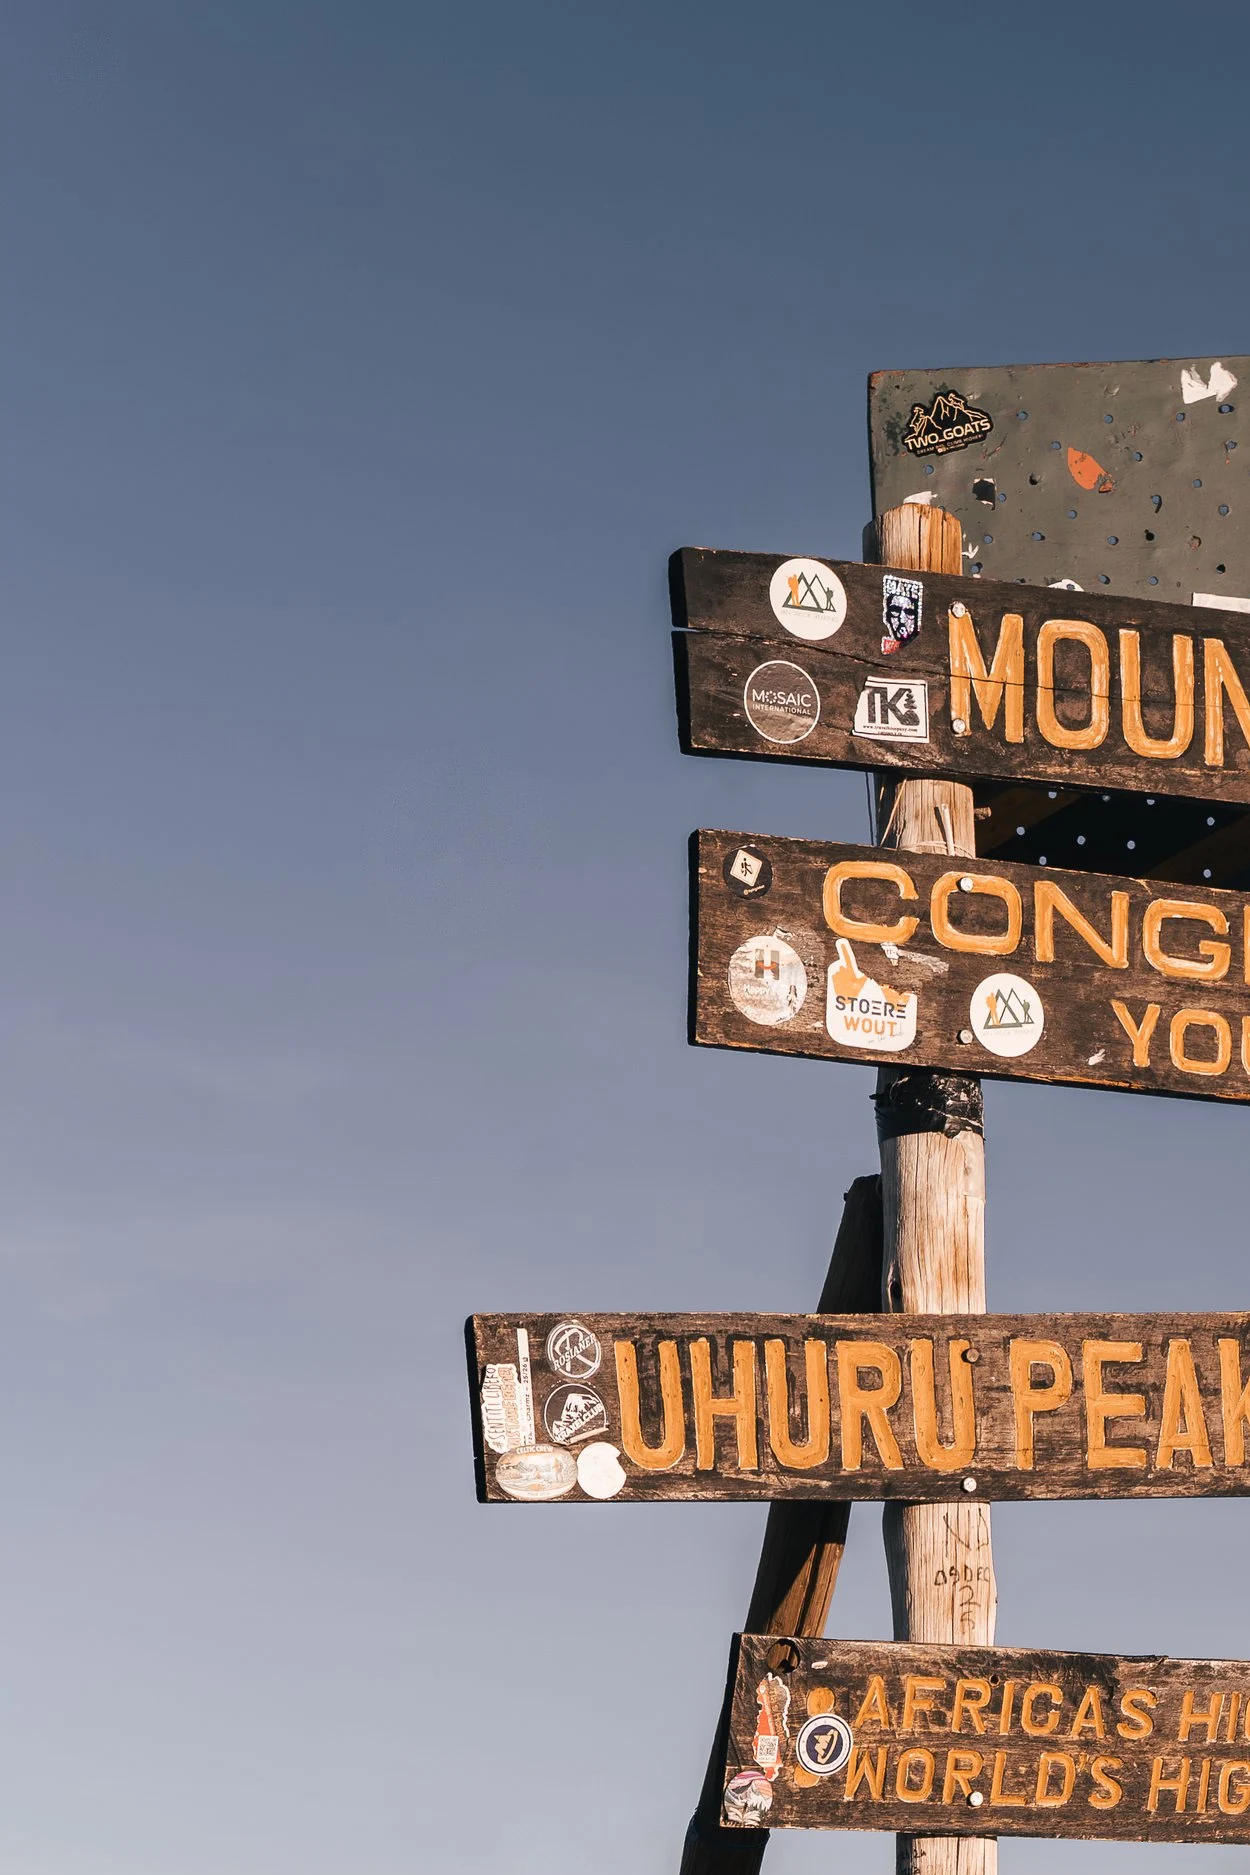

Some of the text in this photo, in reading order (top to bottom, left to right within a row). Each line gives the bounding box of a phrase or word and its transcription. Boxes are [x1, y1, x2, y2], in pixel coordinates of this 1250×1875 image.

[752, 688, 812, 707] MOSAIC
[752, 704, 812, 716] INTERNATIONAL
[836, 995, 907, 1019] STOERE
[844, 1014, 898, 1037] WOUT
[553, 1333, 597, 1371] ROSIANER
[614, 1336, 978, 1471] UHURU
[844, 1745, 1124, 1810] WORLD'S
